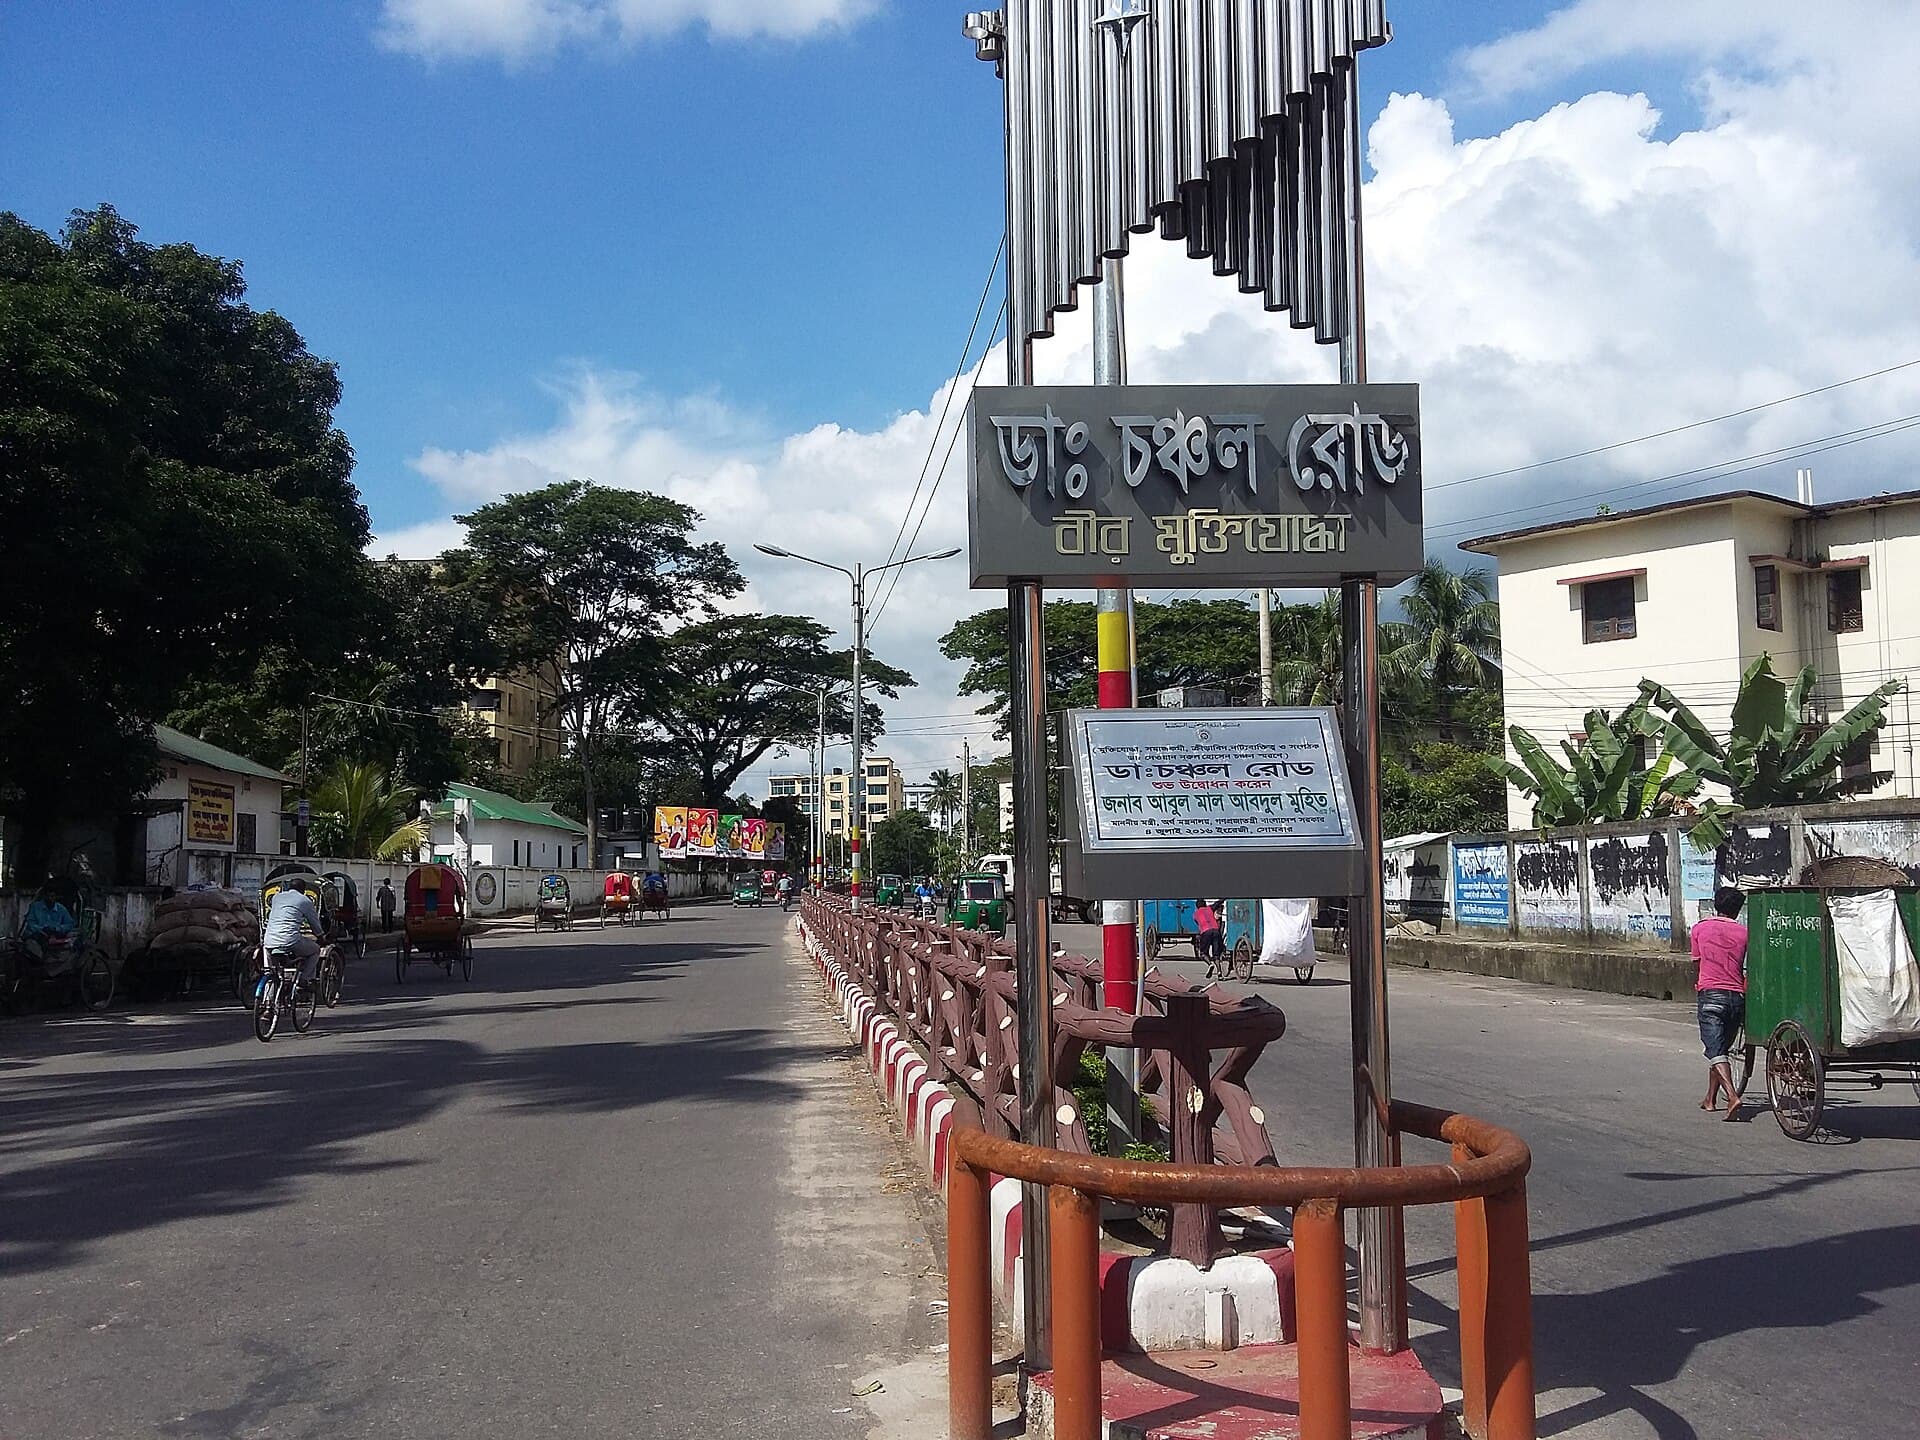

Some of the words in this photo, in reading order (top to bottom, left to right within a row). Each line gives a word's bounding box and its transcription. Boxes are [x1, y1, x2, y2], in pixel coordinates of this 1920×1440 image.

[1110, 407, 1266, 495] চঞ্চল
[1287, 401, 1412, 496] রোড
[1052, 509, 1133, 564] বীর
[1152, 508, 1352, 565] মুক্তিযোদ্ধা
[1246, 761, 1316, 778] রোড
[1152, 780, 1175, 790] শুভ
[1101, 793, 1143, 814] জনাব
[1194, 792, 1225, 812] মাল
